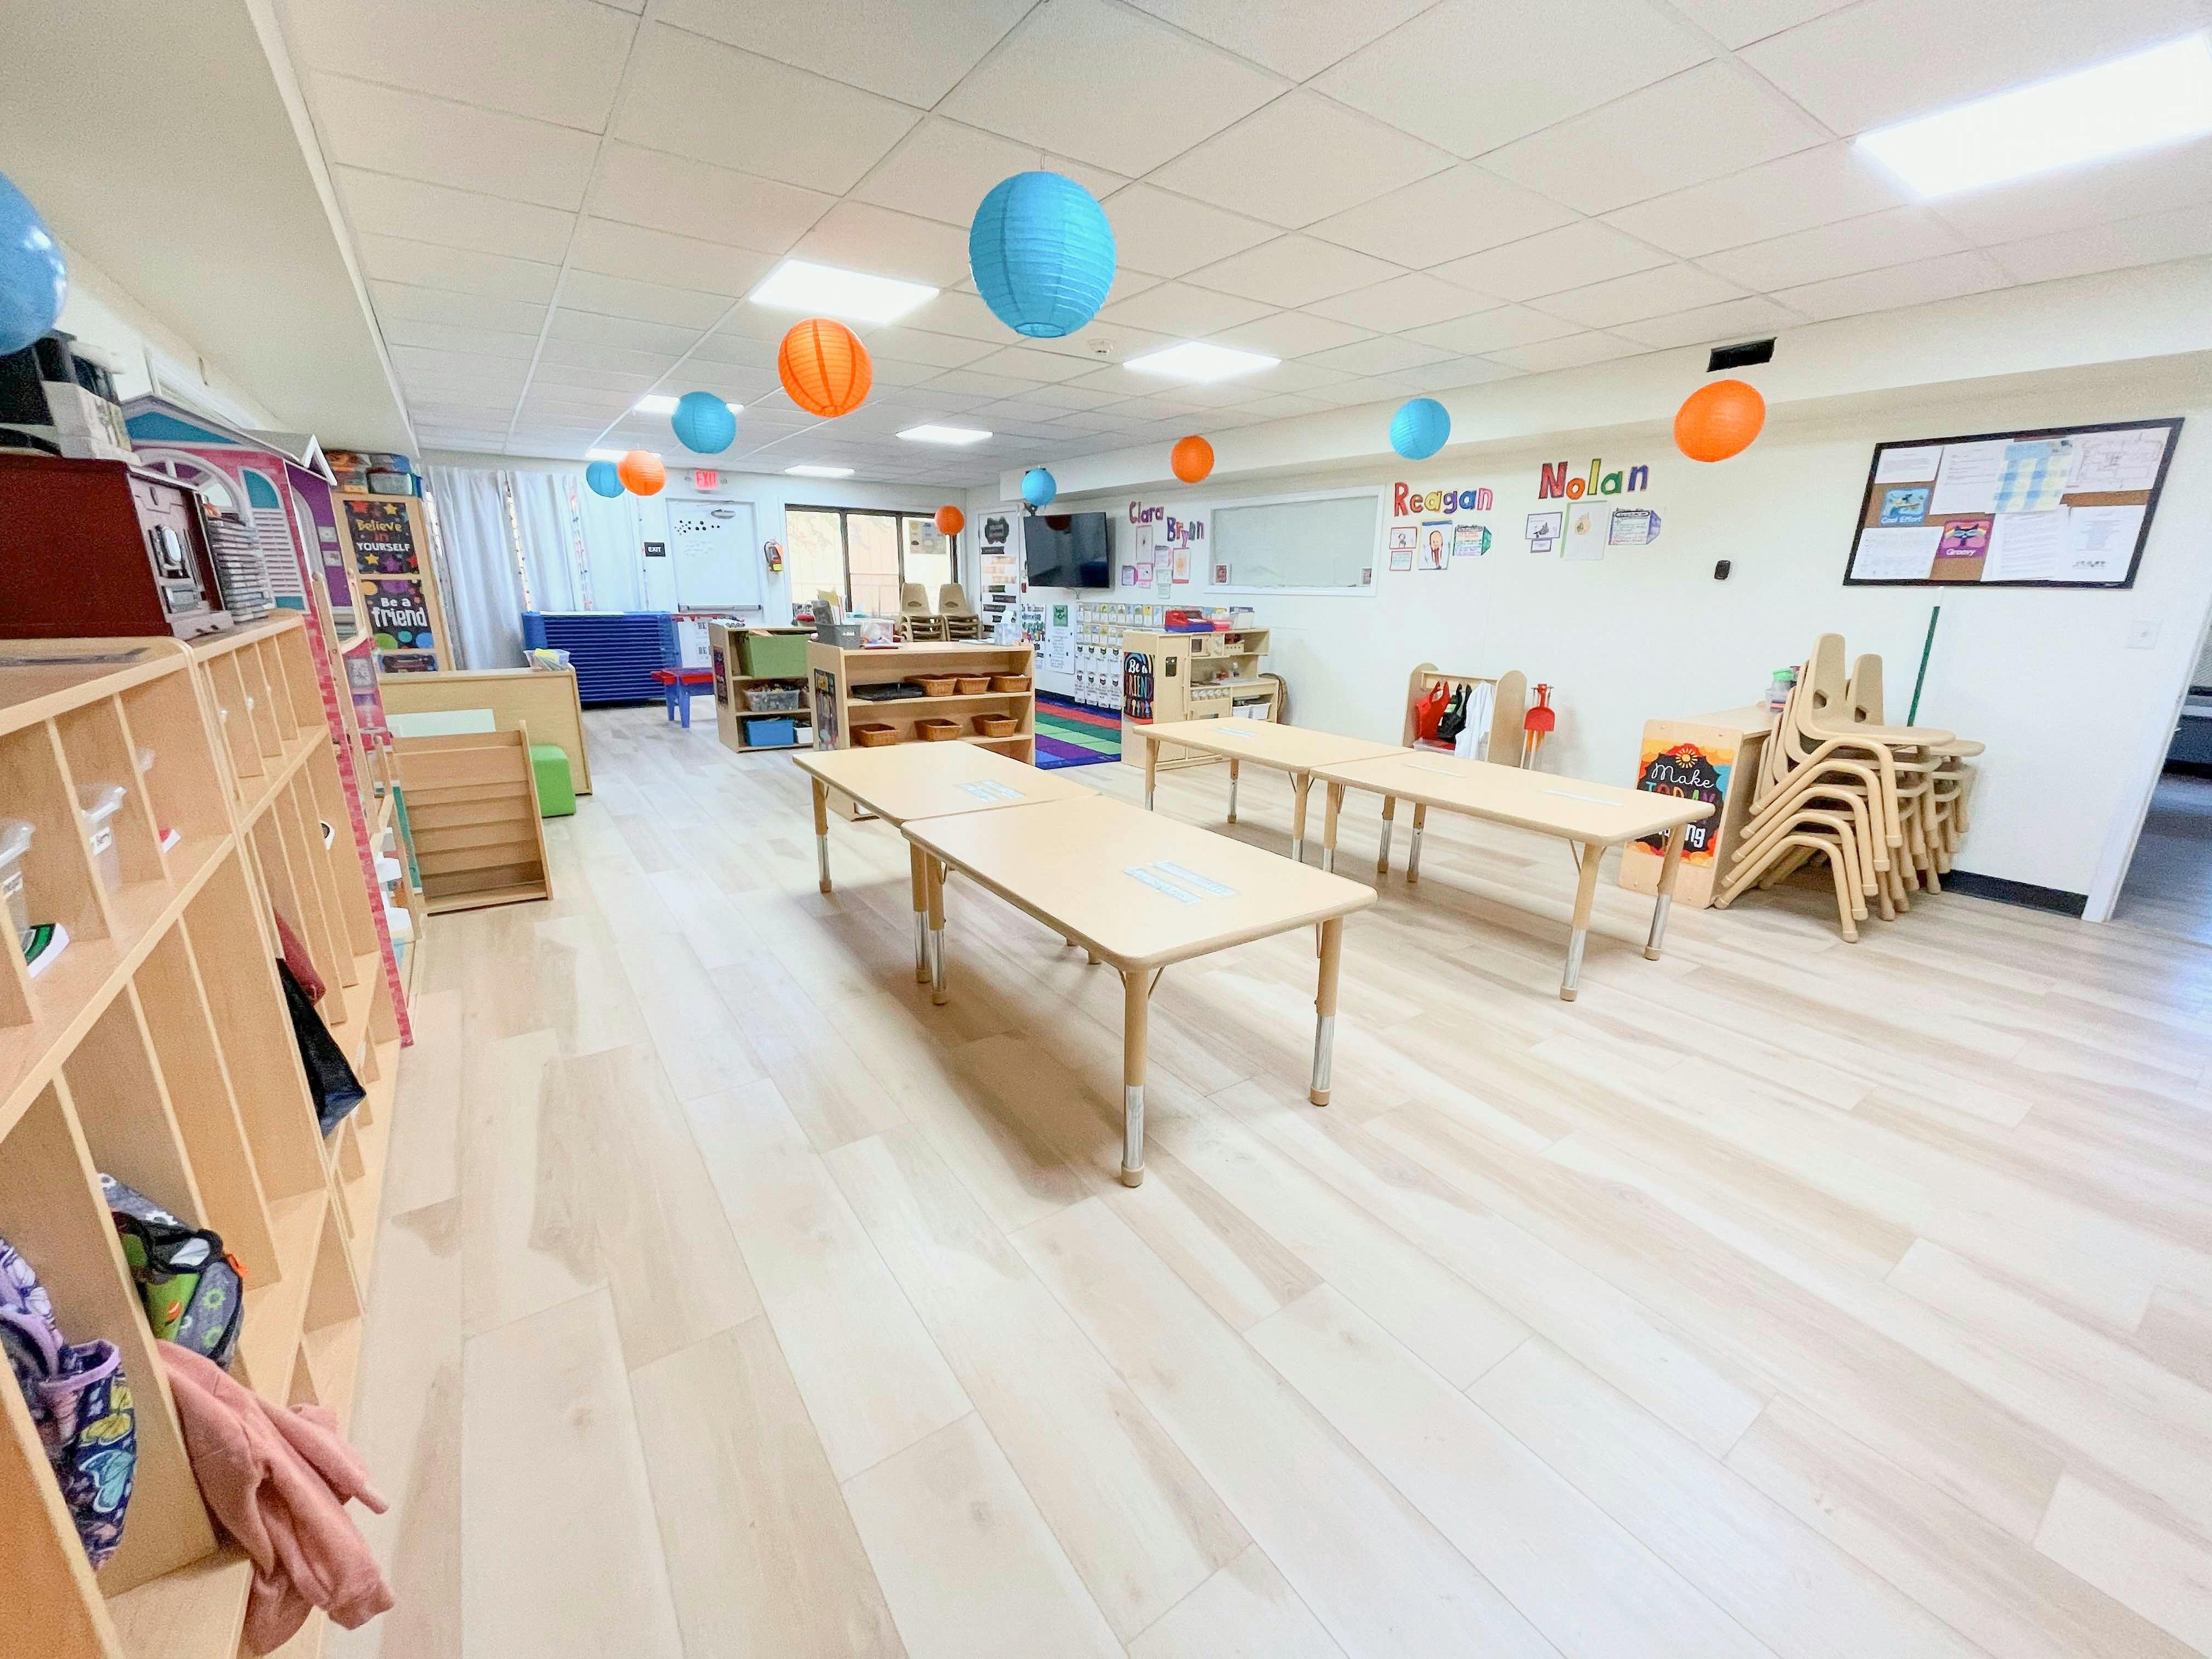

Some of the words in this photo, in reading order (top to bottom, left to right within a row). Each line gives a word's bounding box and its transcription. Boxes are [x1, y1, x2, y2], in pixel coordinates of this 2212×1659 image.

[696, 471, 716, 487] EXIT
[1538, 458, 1649, 500] Nolan
[1394, 482, 1493, 517] Reagan
[1129, 501, 1164, 524] Clara
[356, 519, 402, 531] Believe
[1167, 516, 1204, 549] Bryan
[357, 542, 411, 552] YOURSELF
[1946, 549, 1977, 557] Groovy
[381, 597, 397, 607] Be
[402, 597, 411, 607] a
[371, 607, 428, 628] friend
[1128, 659, 1140, 674] Be
[1651, 763, 1714, 788] Make
